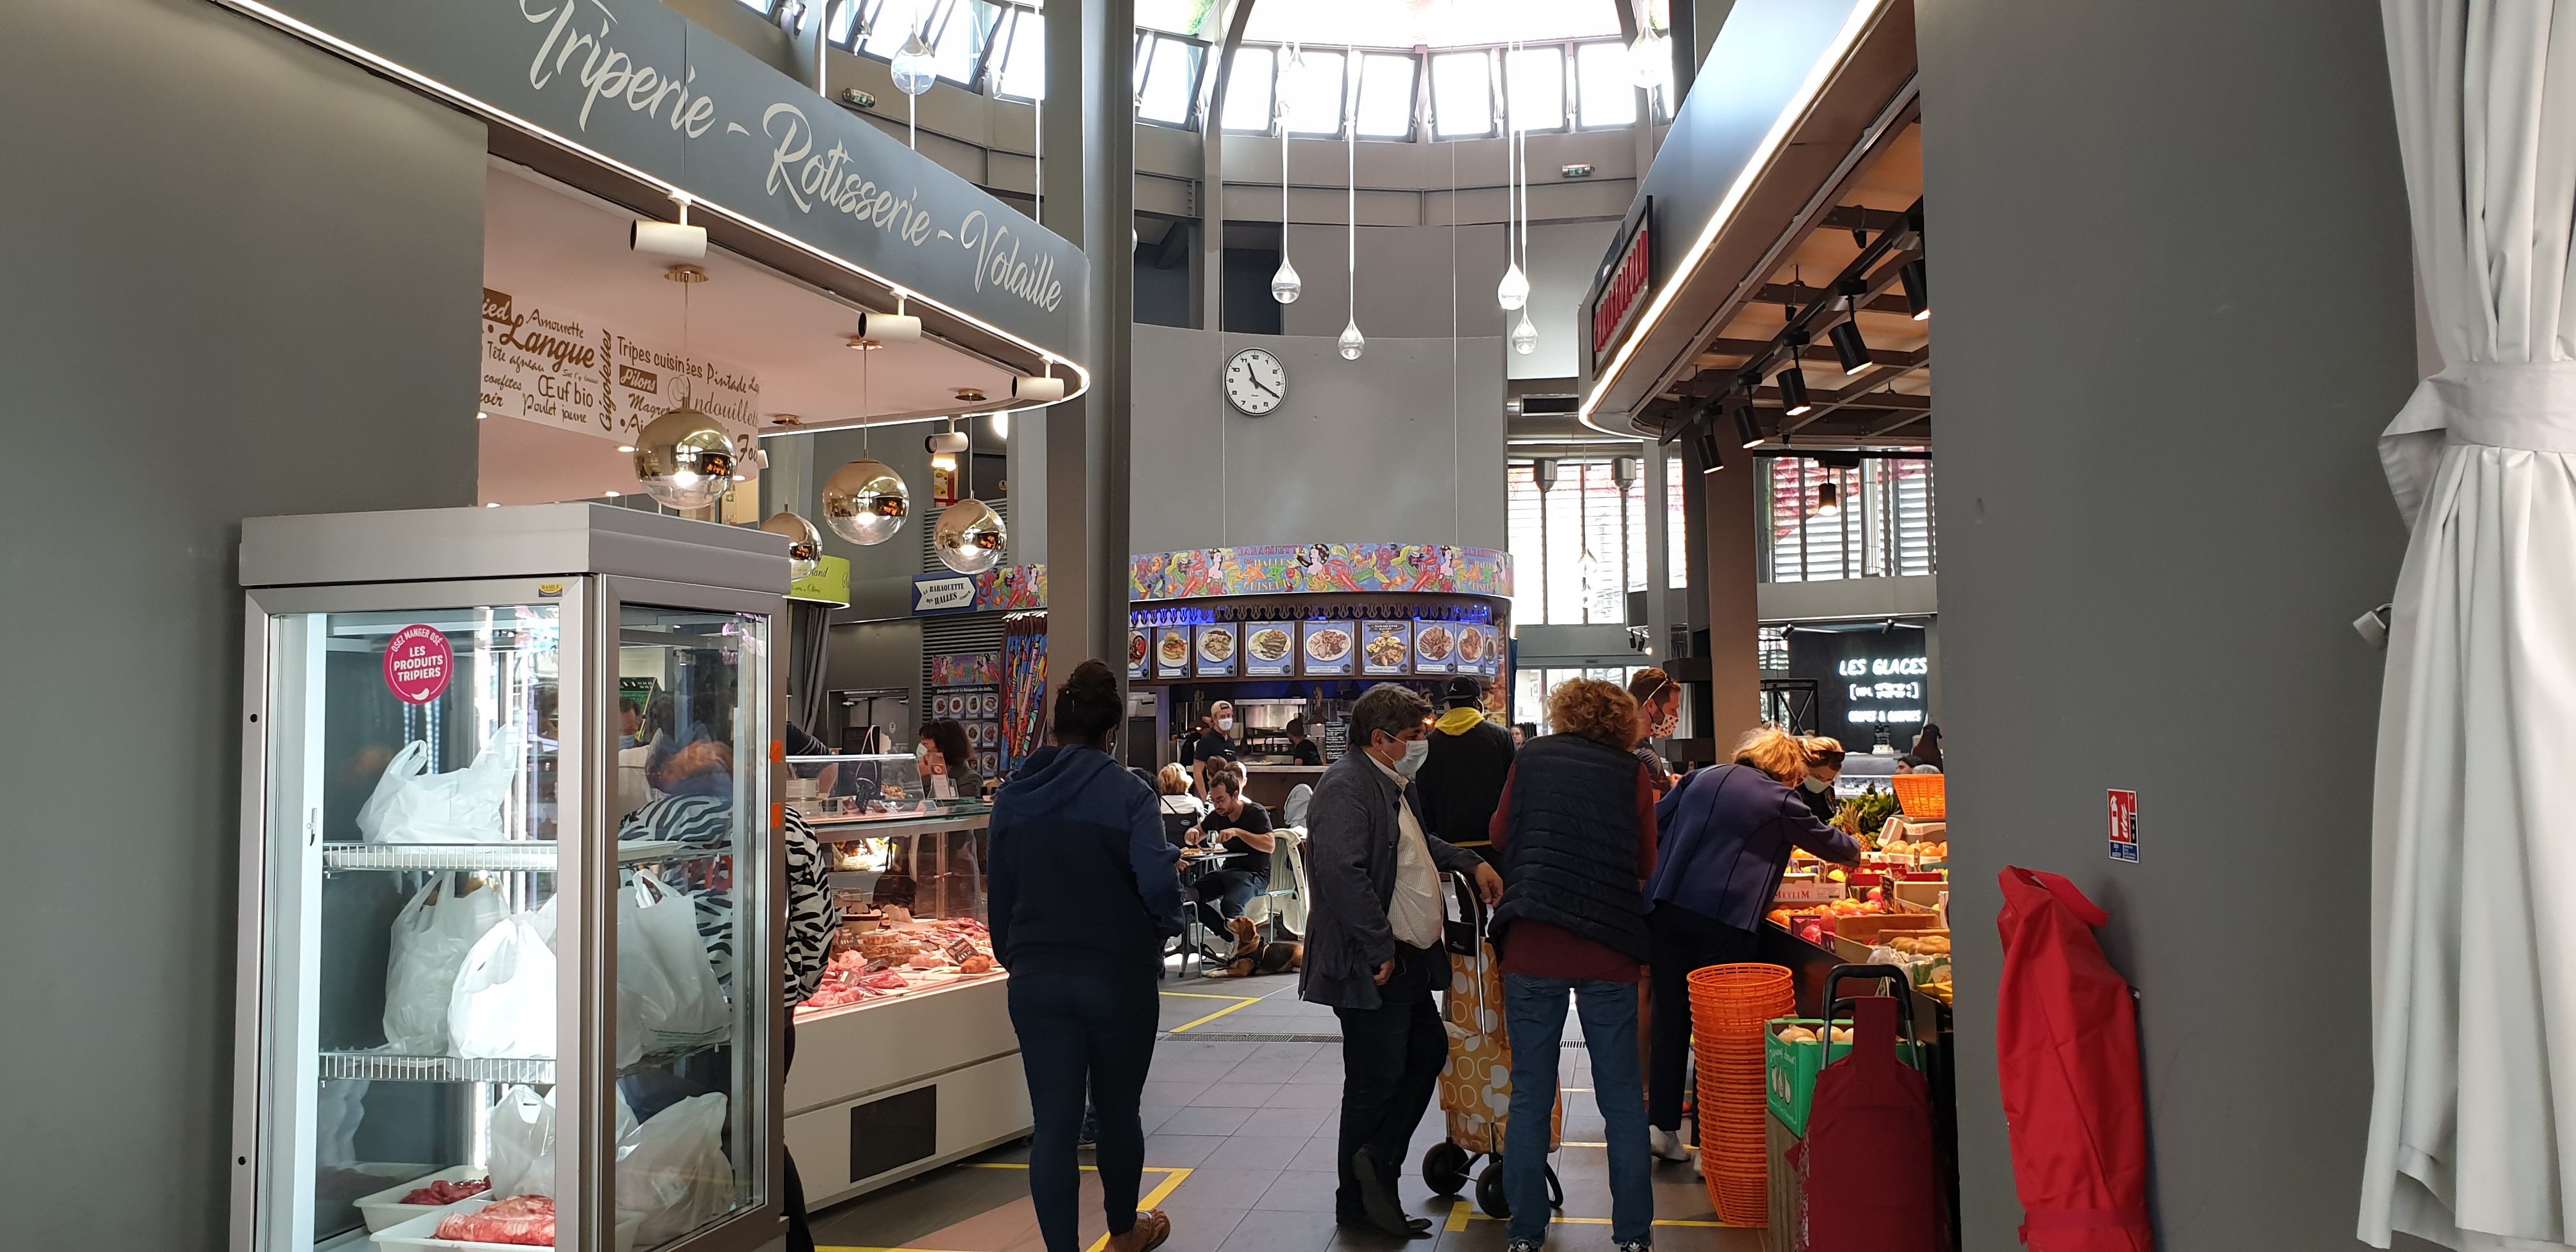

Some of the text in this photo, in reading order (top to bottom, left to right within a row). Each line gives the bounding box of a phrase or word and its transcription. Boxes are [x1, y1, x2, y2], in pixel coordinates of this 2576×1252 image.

[519, 0, 716, 139] Triperie
[960, 210, 1062, 313] Volaille
[526, 309, 584, 339] Amourette
[487, 340, 545, 374] Tête agneau
[499, 314, 595, 373] Langue
[617, 335, 703, 379] Tripes cuisinées
[537, 374, 594, 408] Œuf bio
[620, 368, 656, 392] Pilons
[707, 362, 747, 394] Pintade
[522, 392, 587, 423] Poulet jaune
[930, 583, 965, 592] BARAQUETTE
[934, 592, 958, 605] HALLES
[390, 628, 444, 653] OSEZ MANGER OSÉ
[410, 645, 426, 657] LES
[394, 655, 444, 671] PRODUITS
[397, 667, 441, 682] TRIPIERS
[1839, 657, 1928, 676] LES GLACES
